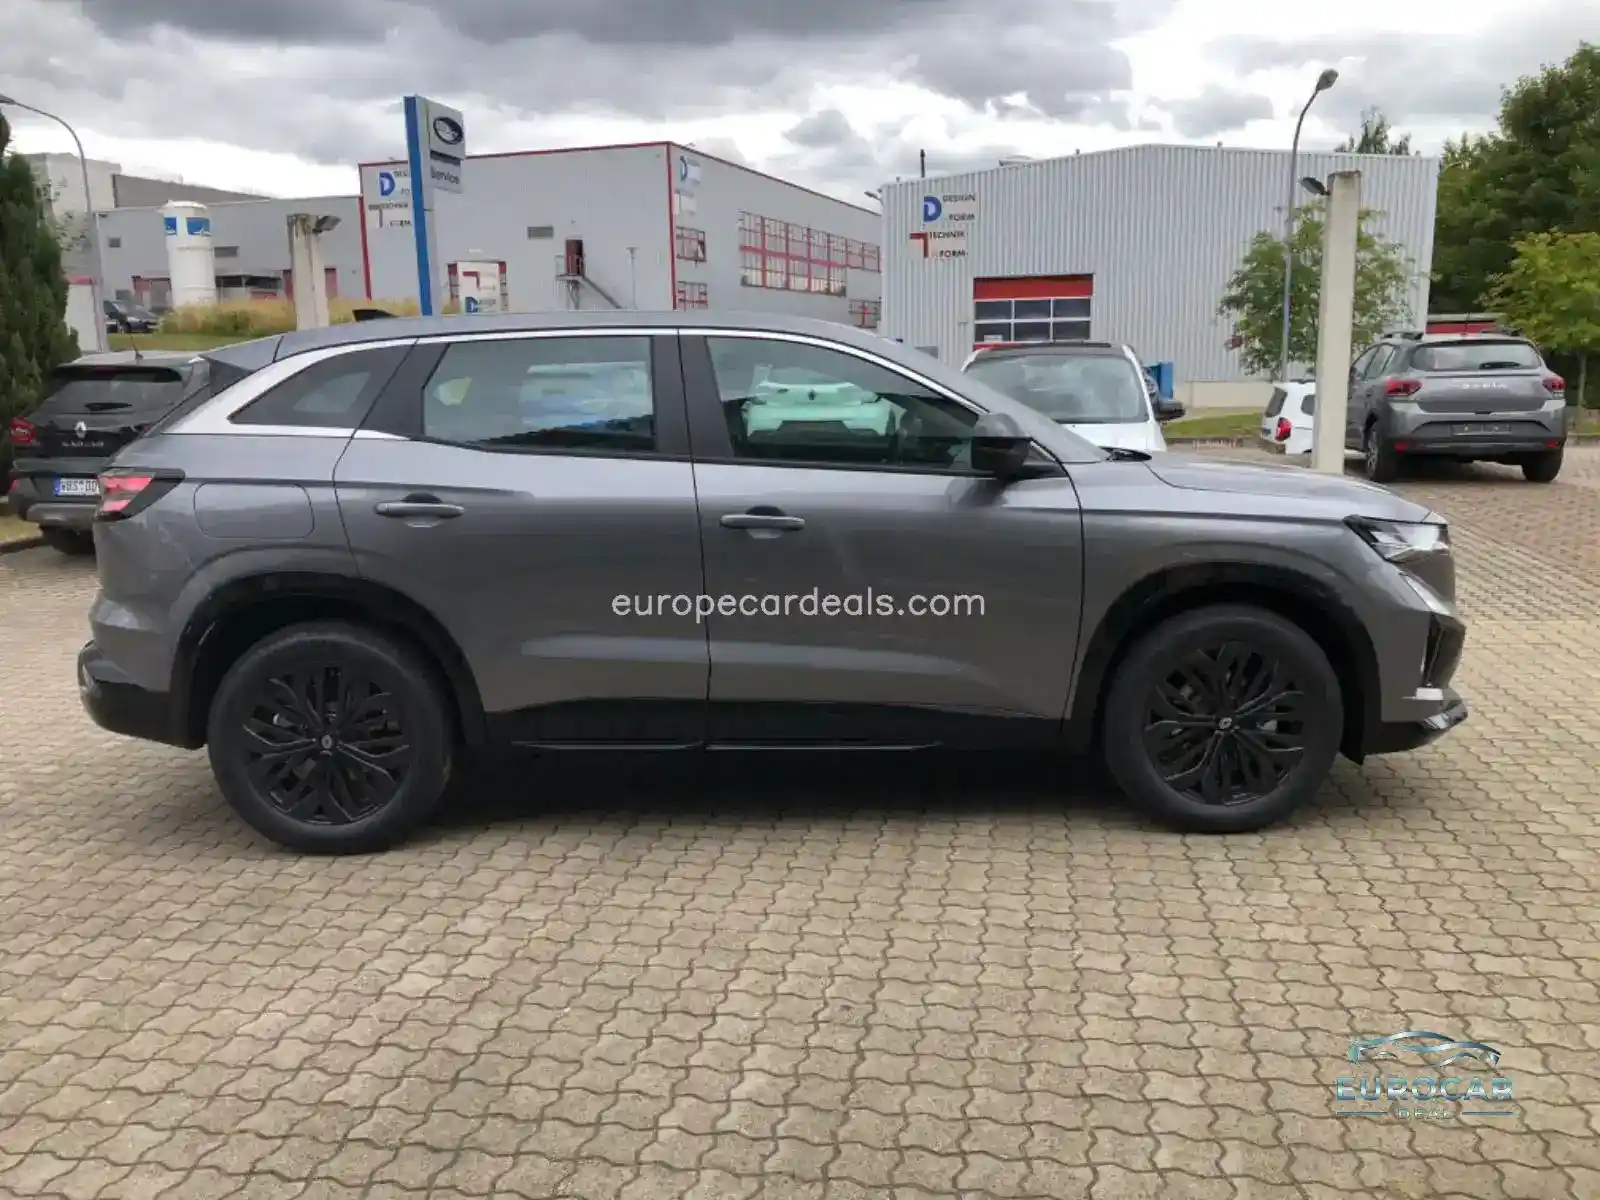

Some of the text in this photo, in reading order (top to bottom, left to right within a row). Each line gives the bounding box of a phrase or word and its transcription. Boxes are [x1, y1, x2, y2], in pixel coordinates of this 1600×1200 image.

[923, 195, 942, 222] D
[948, 213, 976, 222] FORM
[939, 249, 967, 258] FORM
